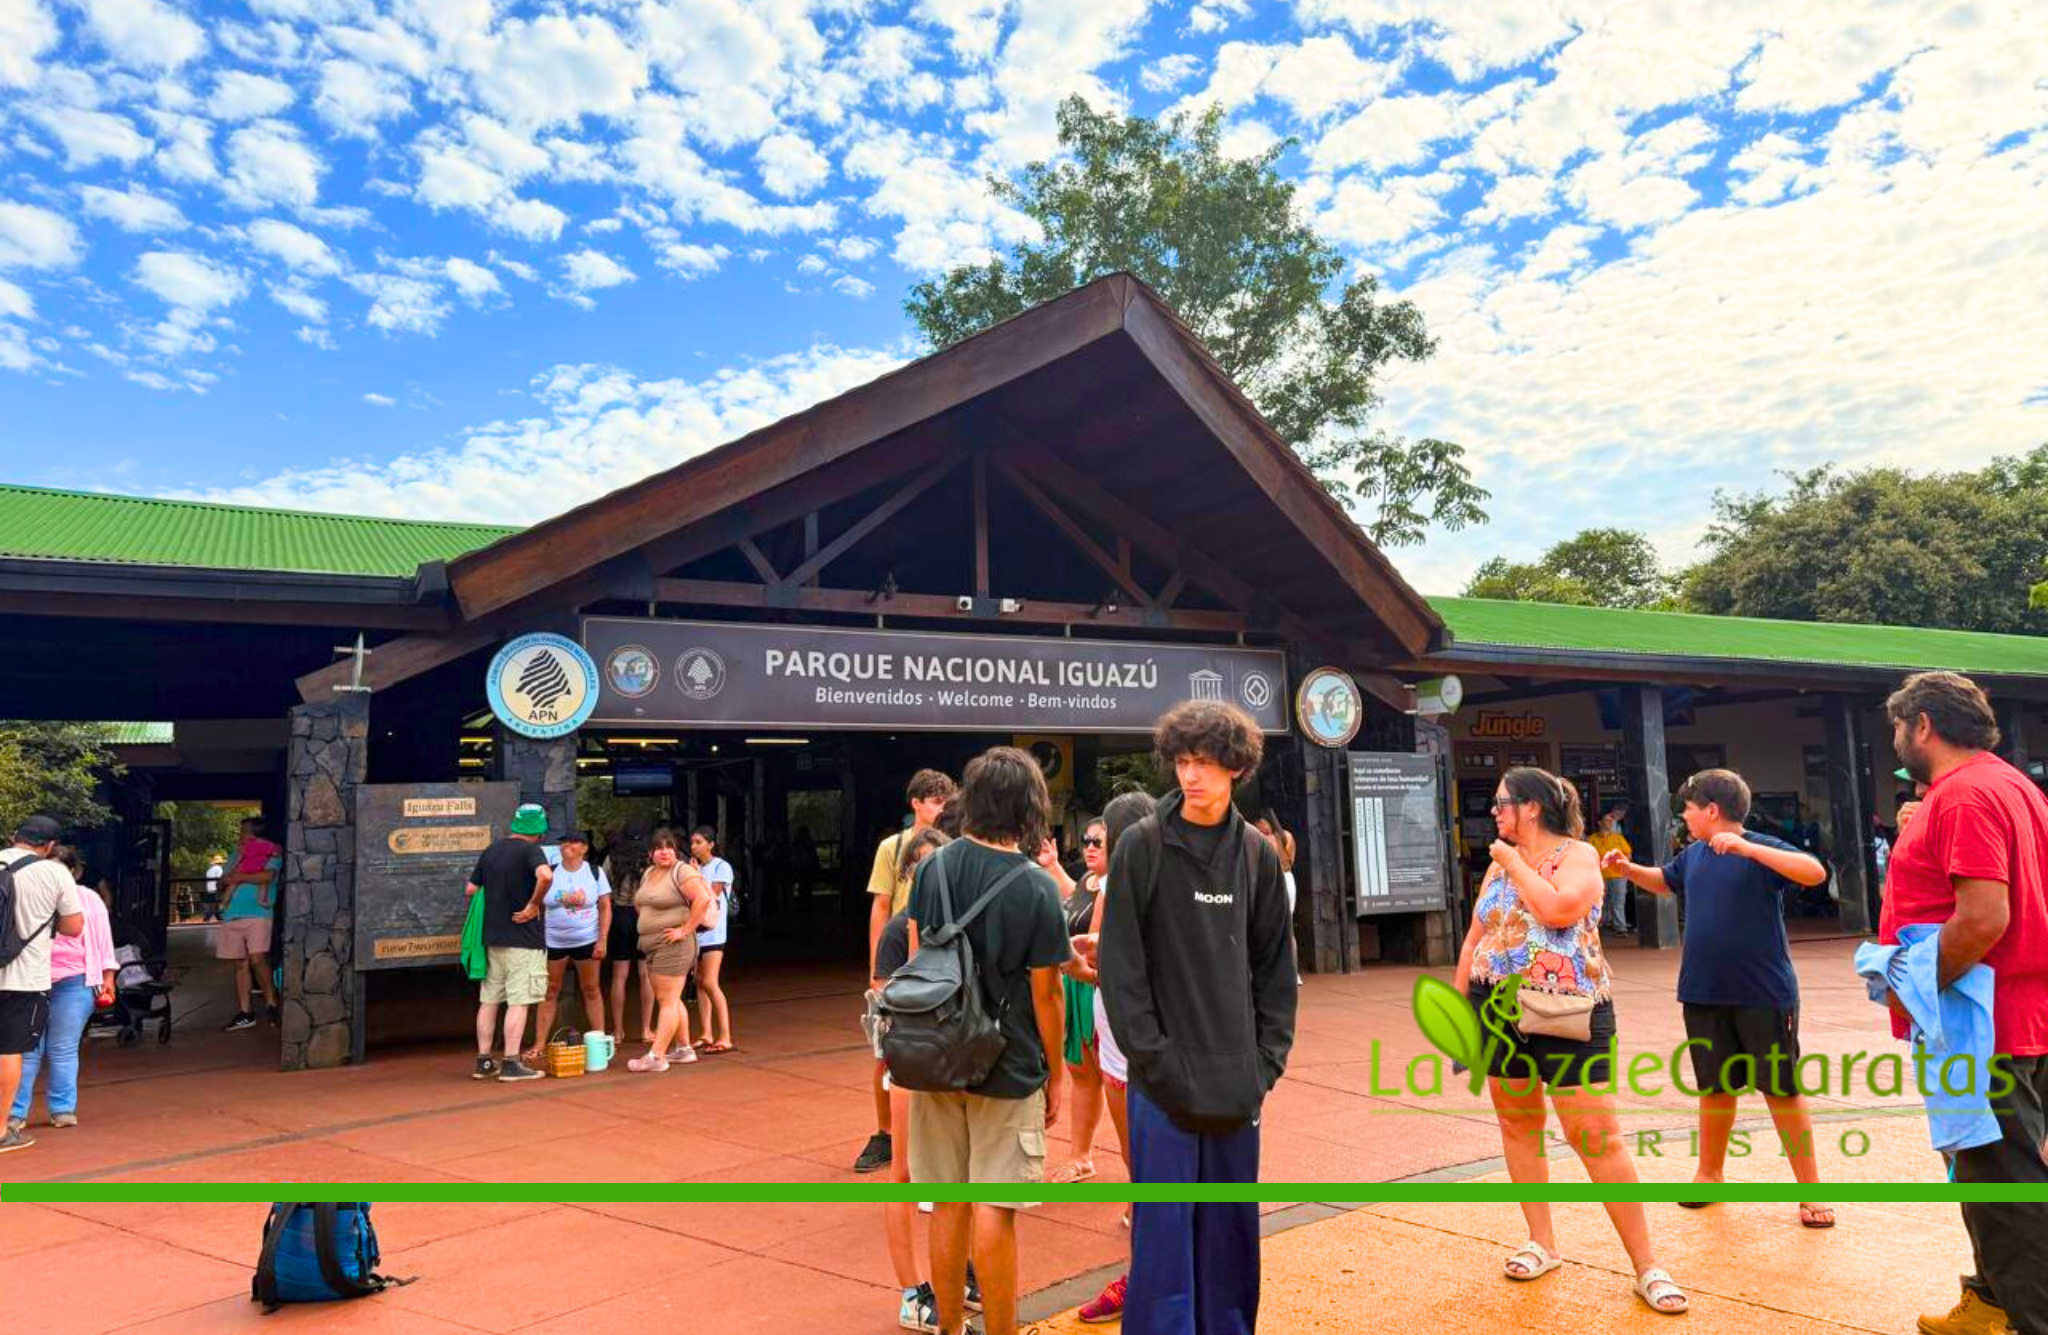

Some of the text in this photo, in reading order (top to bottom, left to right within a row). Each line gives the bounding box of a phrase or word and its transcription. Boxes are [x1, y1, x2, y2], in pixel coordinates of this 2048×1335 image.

[765, 649, 1157, 688] PARQUE NACIONAL IGUAZÚ
[815, 687, 1117, 709] Bienvenidos Welcome Bem-vindos
[528, 710, 558, 721] APN
[1471, 710, 1545, 741] Jungle
[447, 800, 473, 811] Falls
[1194, 891, 1233, 904] MOON
